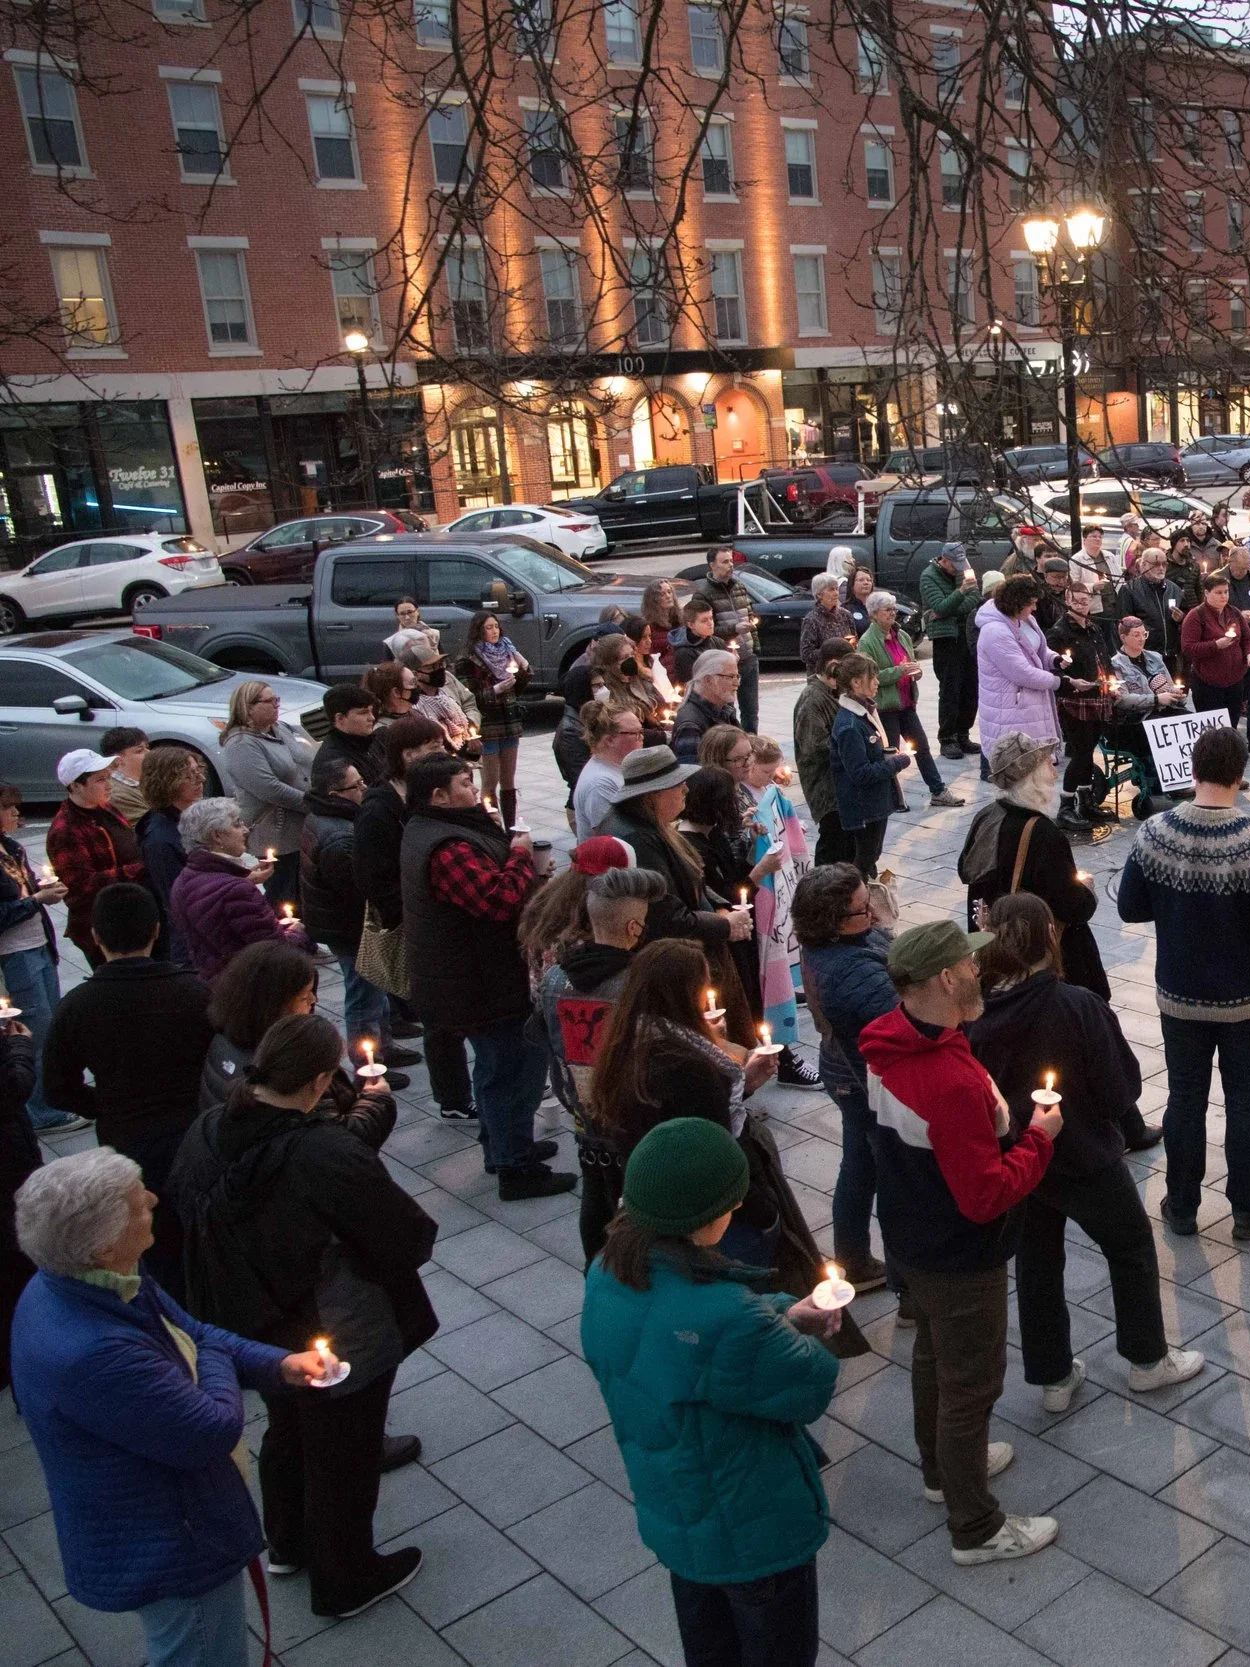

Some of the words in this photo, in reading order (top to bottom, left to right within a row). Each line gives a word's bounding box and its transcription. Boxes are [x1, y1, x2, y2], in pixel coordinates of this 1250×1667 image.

[1009, 347, 1037, 356] COFEE
[619, 356, 645, 373] 100
[109, 466, 156, 482] Twelve
[160, 465, 175, 479] 31
[211, 482, 236, 494] Capitol
[237, 482, 255, 493] Copy
[256, 481, 267, 490] Inc
[1151, 723, 1179, 749] LET
[1181, 715, 1224, 740] TRANS
[1178, 742, 1196, 759] KI
[1159, 761, 1192, 783] LIVE
